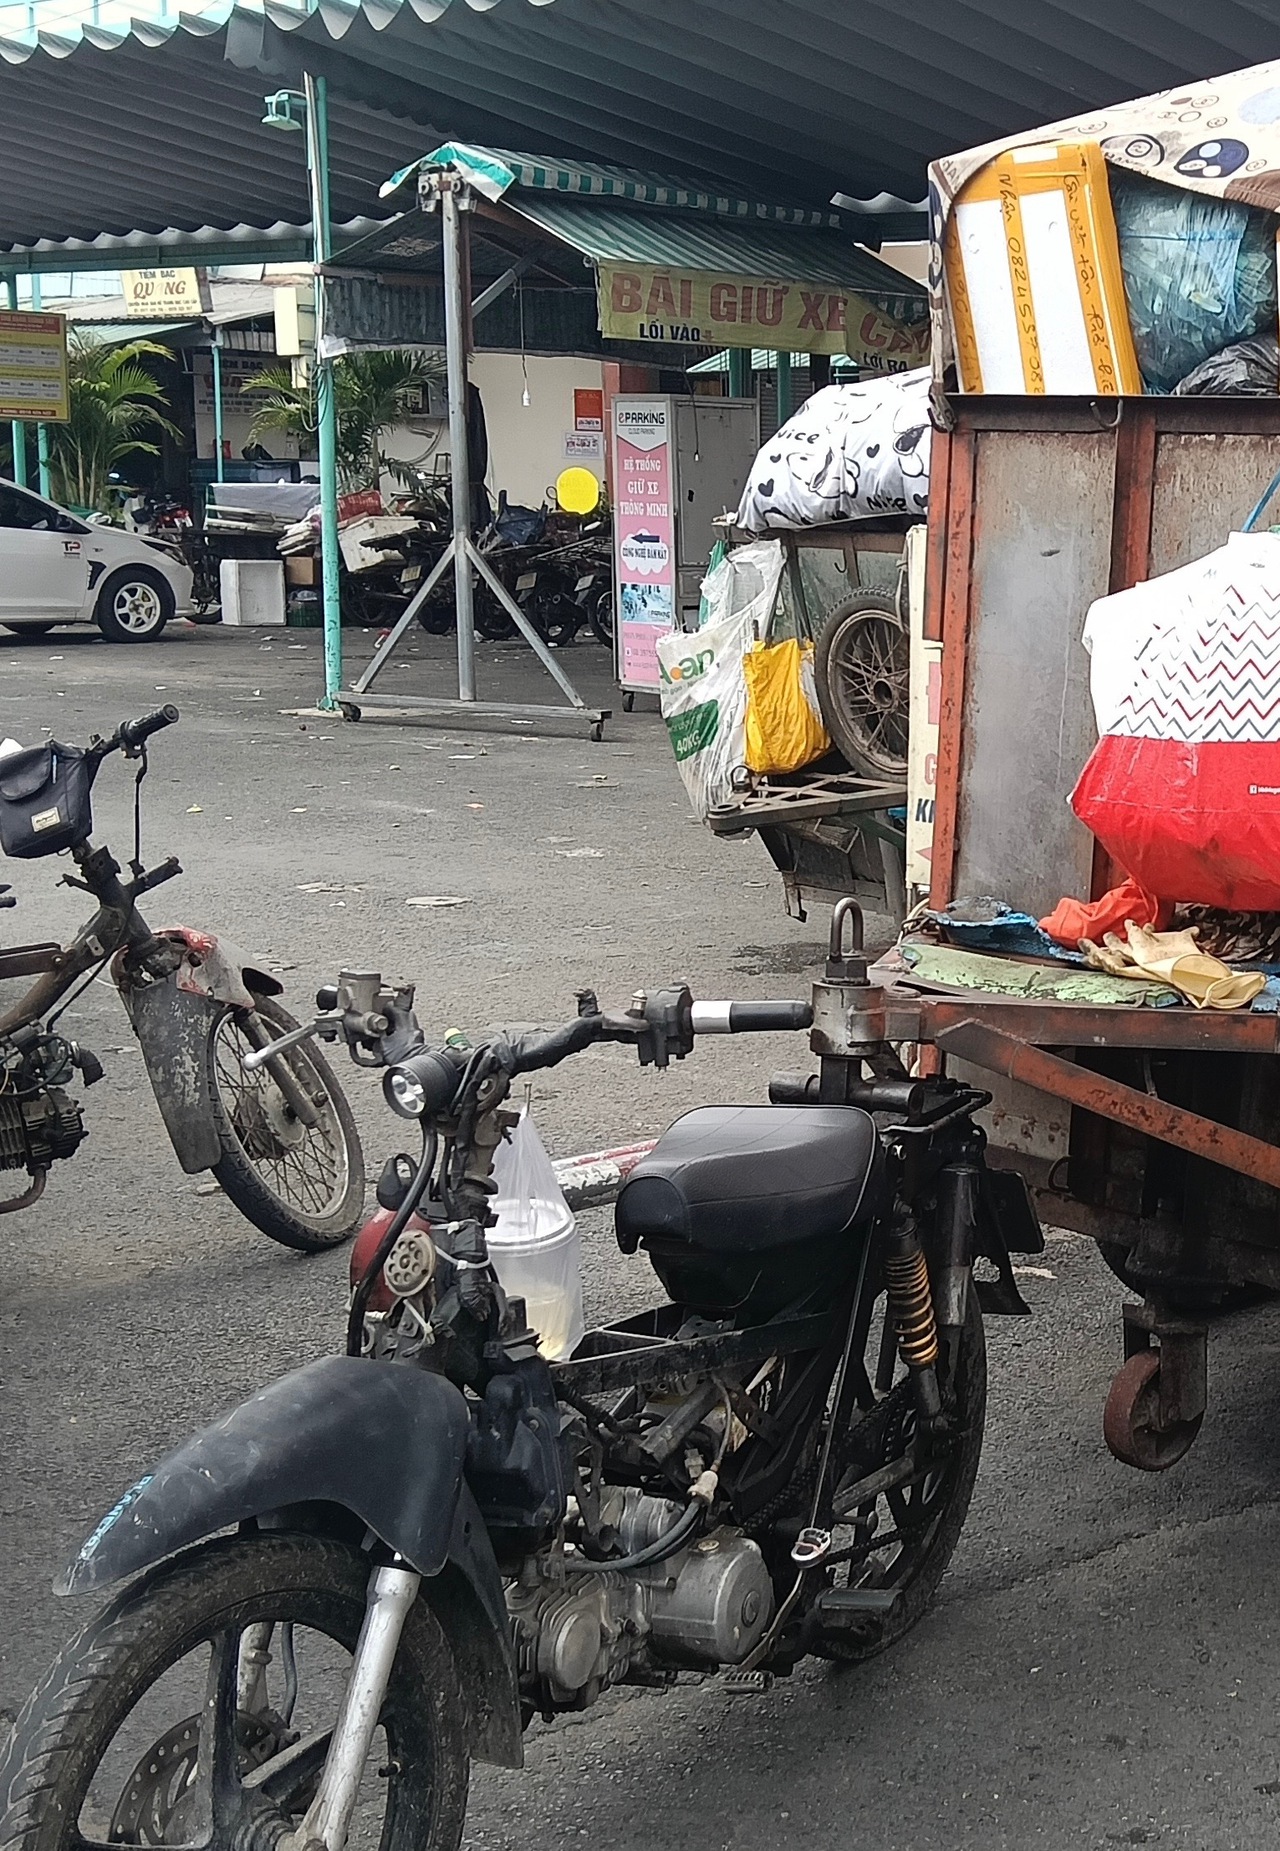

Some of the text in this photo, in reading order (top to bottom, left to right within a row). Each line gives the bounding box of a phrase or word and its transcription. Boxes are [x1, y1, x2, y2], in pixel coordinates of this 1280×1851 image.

[611, 268, 692, 319] BÃI
[710, 280, 790, 327] GIỮ
[797, 291, 848, 331] XE
[639, 321, 700, 342] LỐI VÀO
[624, 455, 661, 473] HỆ THỐNG
[627, 478, 659, 495] GIỮ XE
[646, 503, 668, 517] MINH
